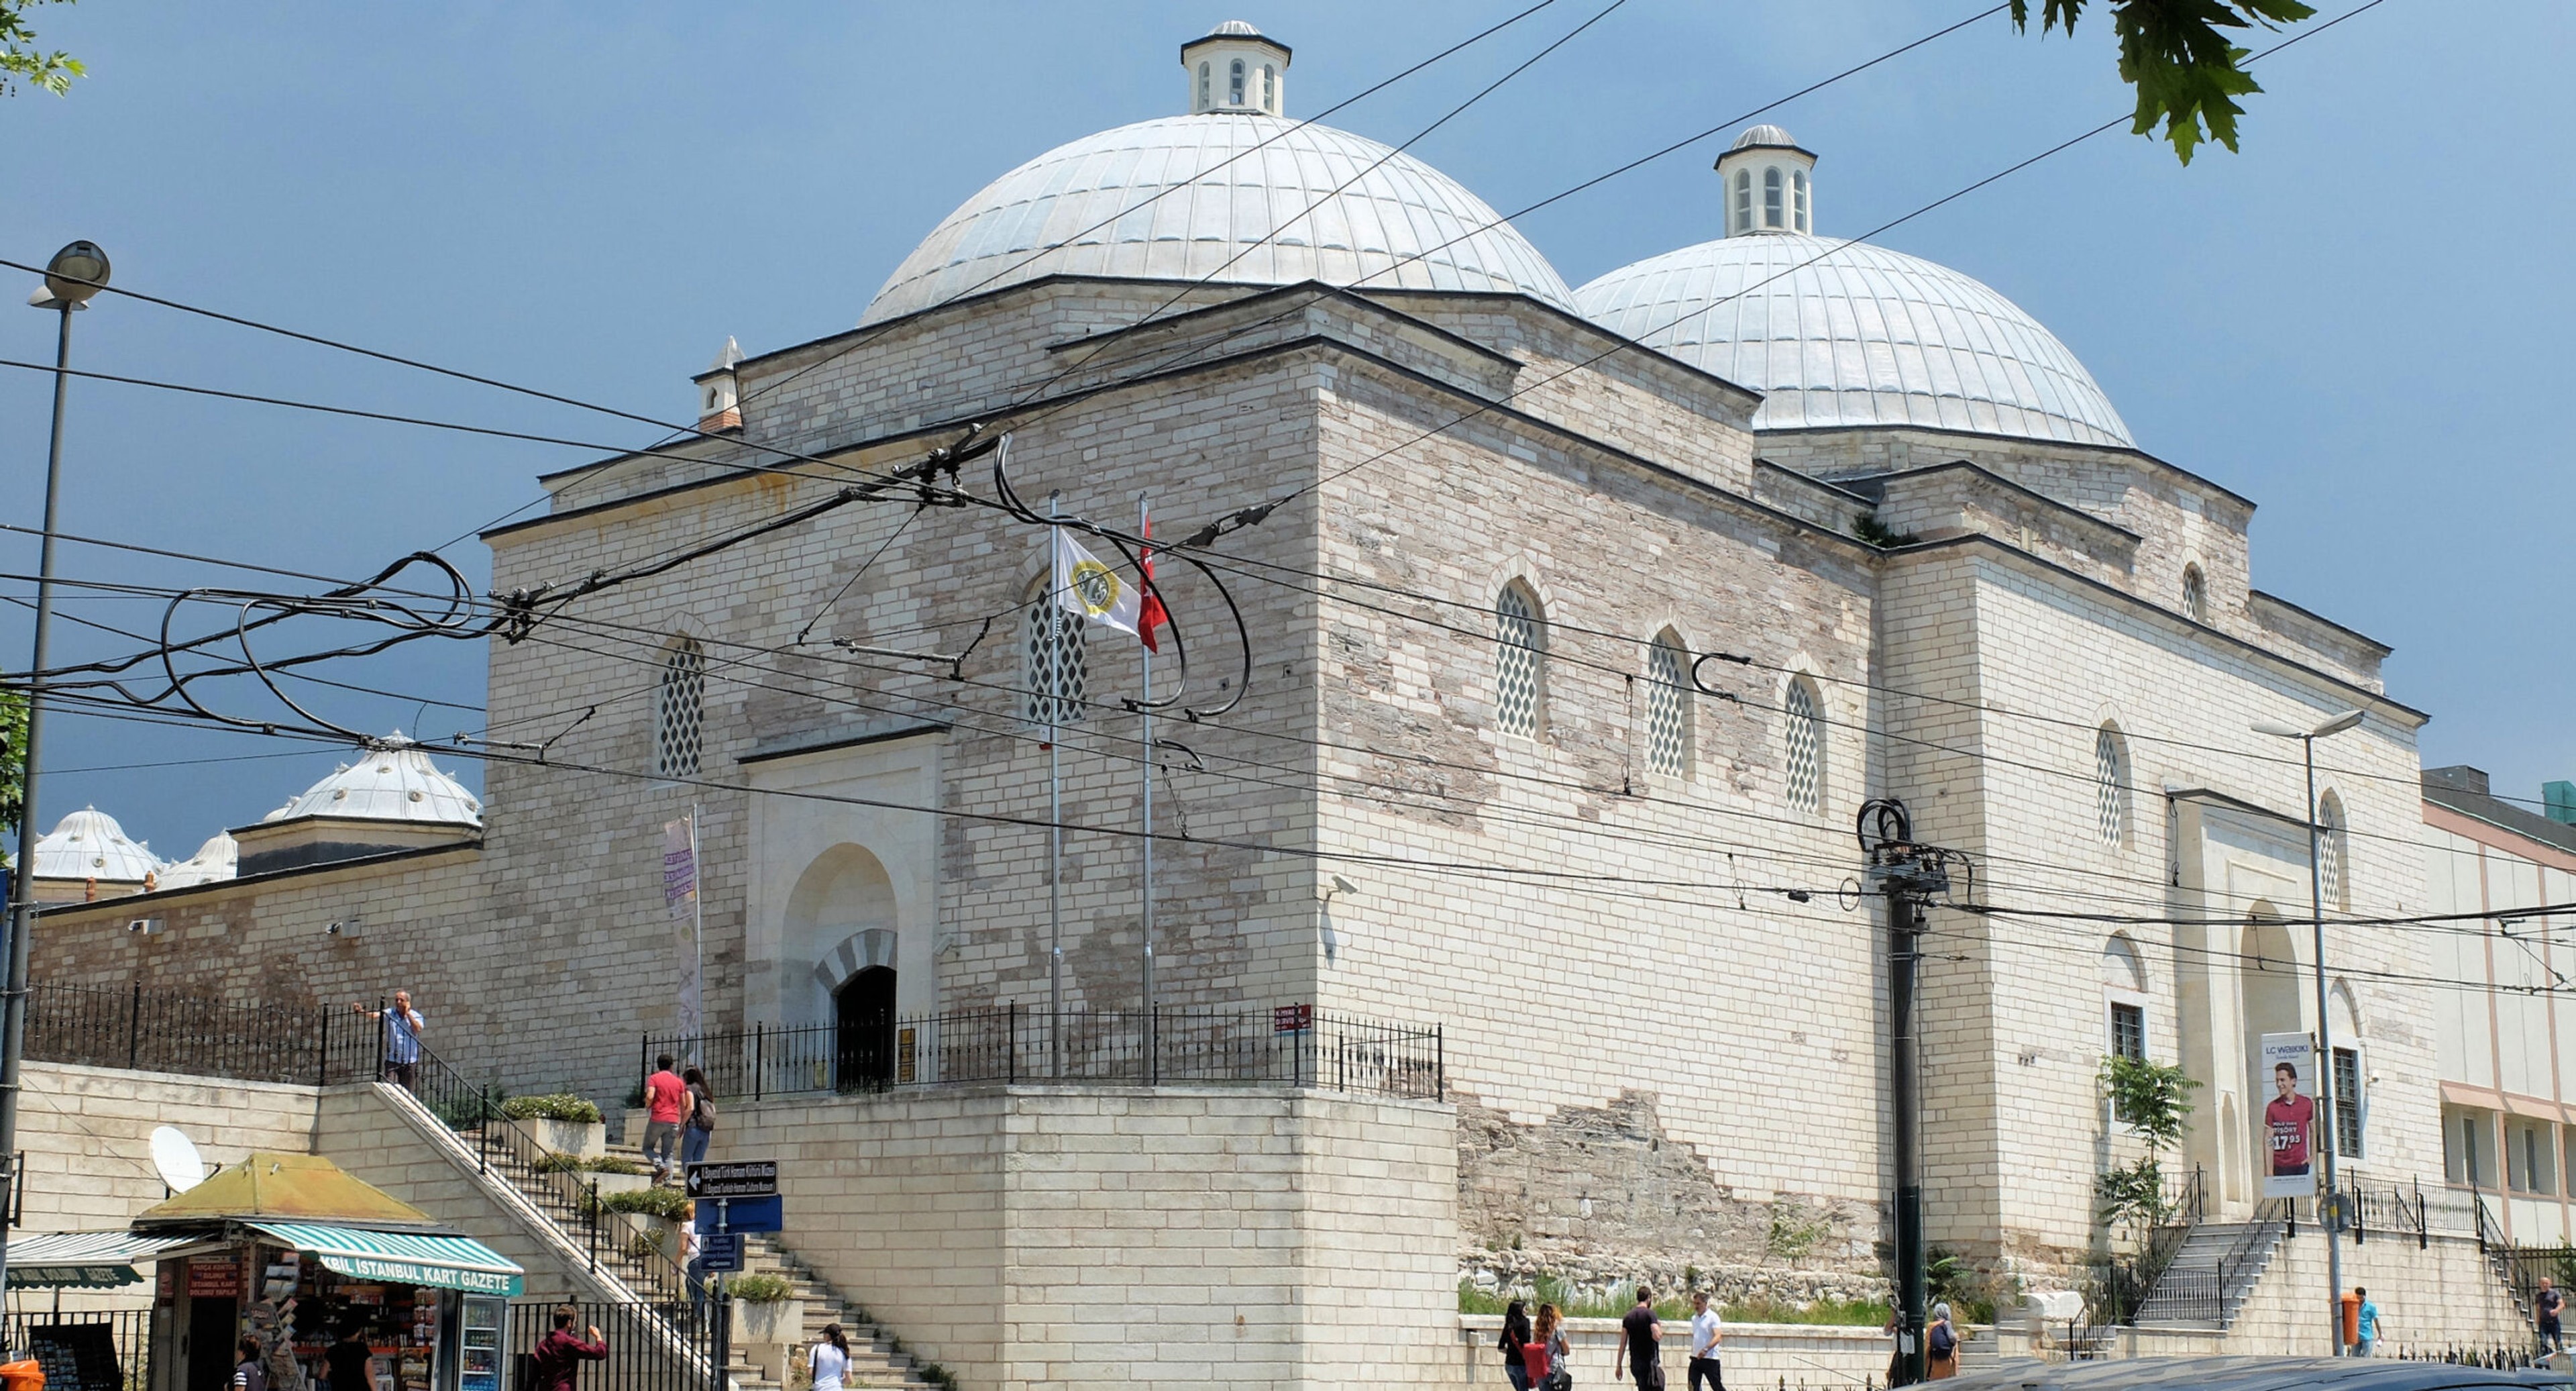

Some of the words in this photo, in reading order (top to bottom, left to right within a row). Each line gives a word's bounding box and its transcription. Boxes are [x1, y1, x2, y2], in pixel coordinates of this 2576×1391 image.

[356, 1257, 421, 1280] İSTANBUL
[423, 1267, 458, 1285] KART
[461, 1272, 509, 1290] GAZETE
